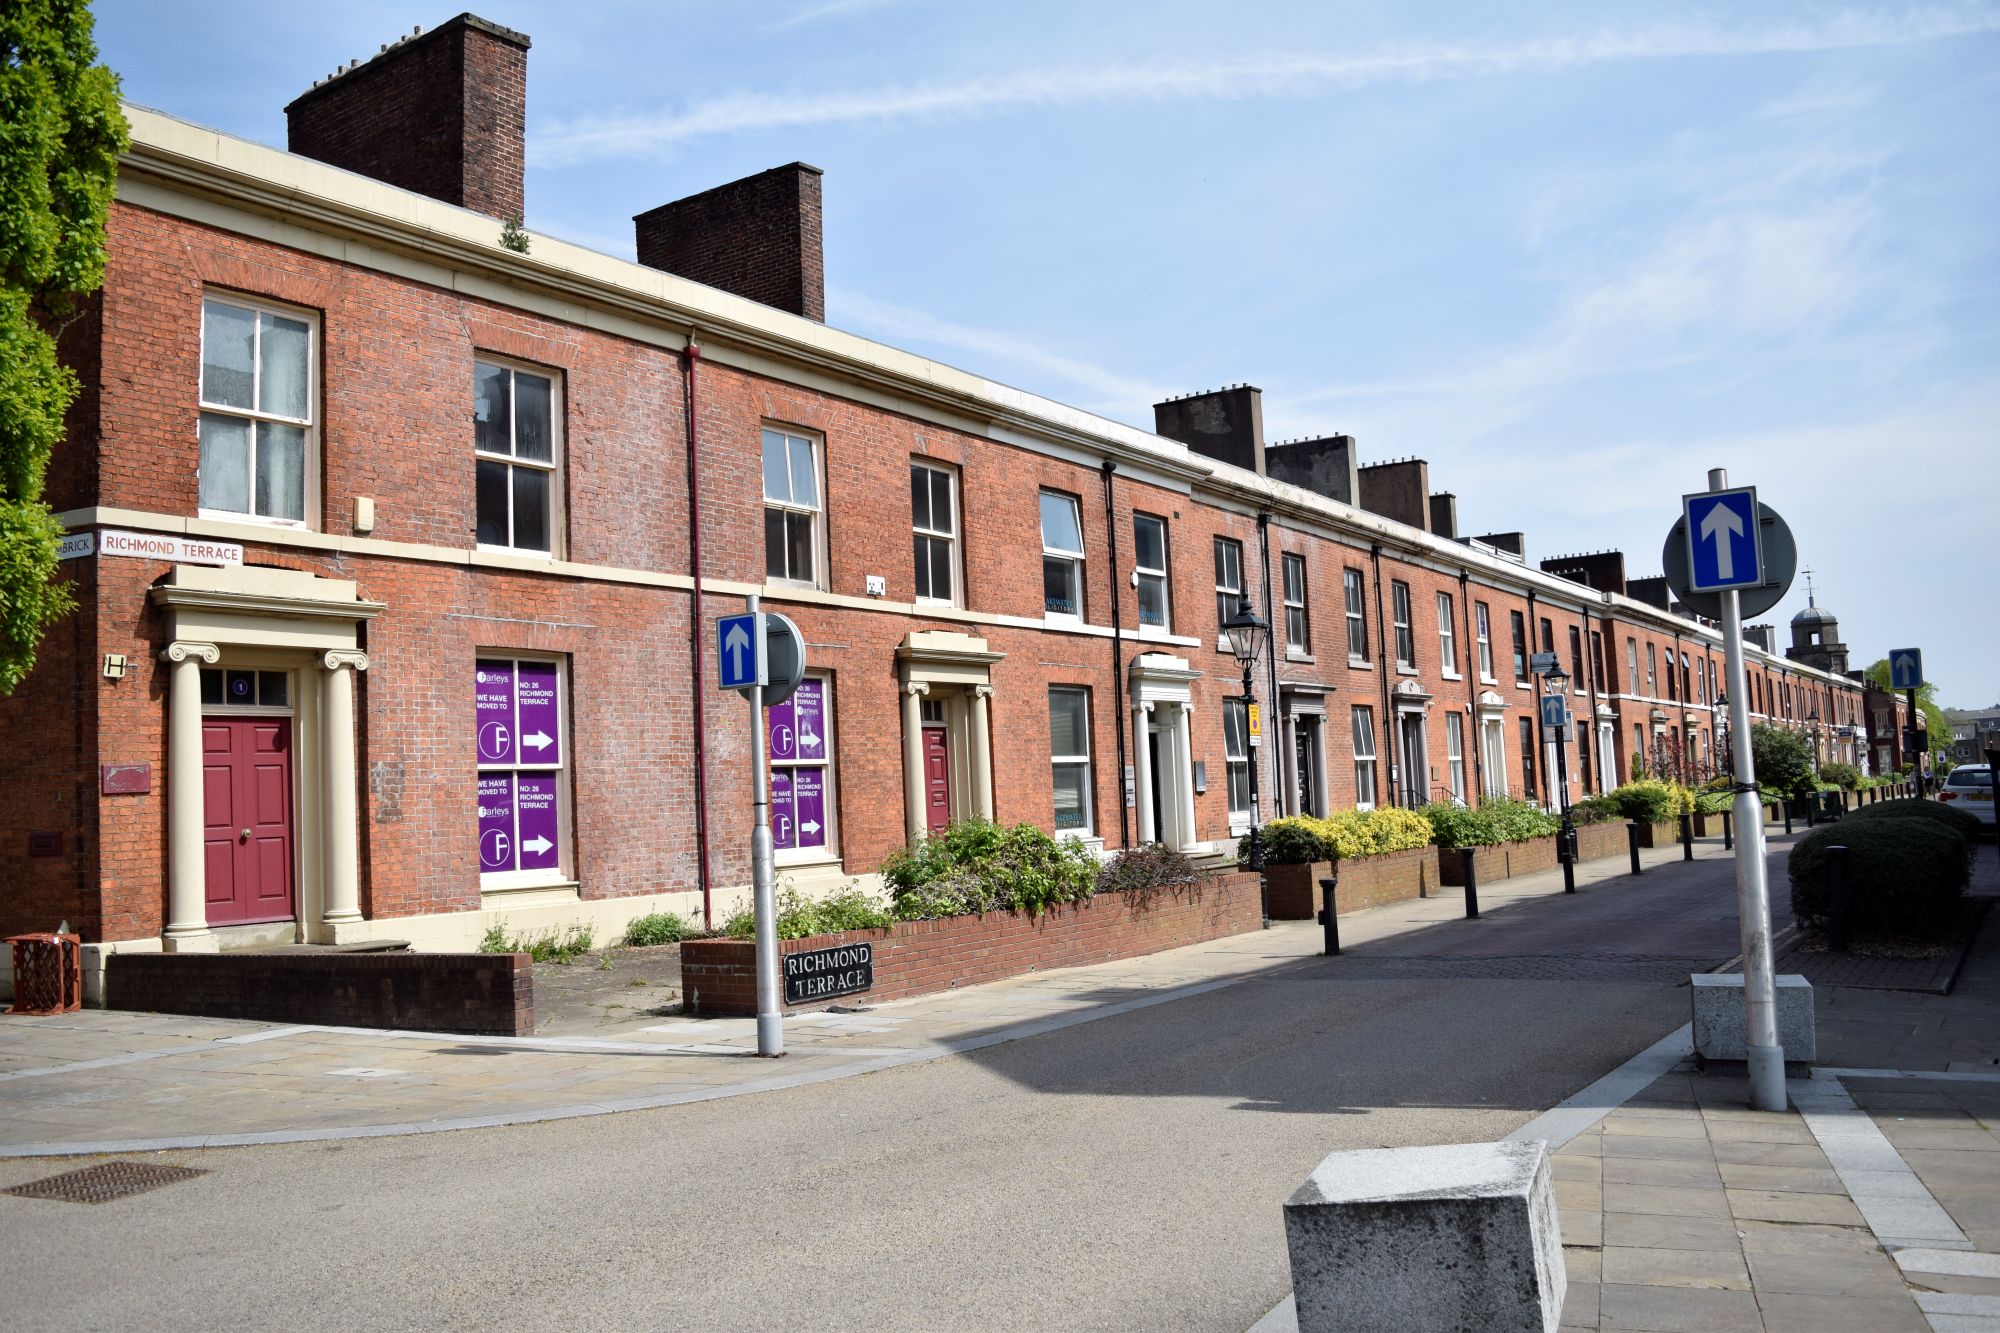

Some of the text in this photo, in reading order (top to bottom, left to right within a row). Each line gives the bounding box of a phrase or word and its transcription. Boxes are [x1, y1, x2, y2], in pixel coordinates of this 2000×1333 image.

[106, 536, 238, 560] RICHMOND TERRACE
[107, 656, 124, 675] H
[788, 947, 869, 975] RICHMOND
[795, 970, 865, 997] TERRACE
